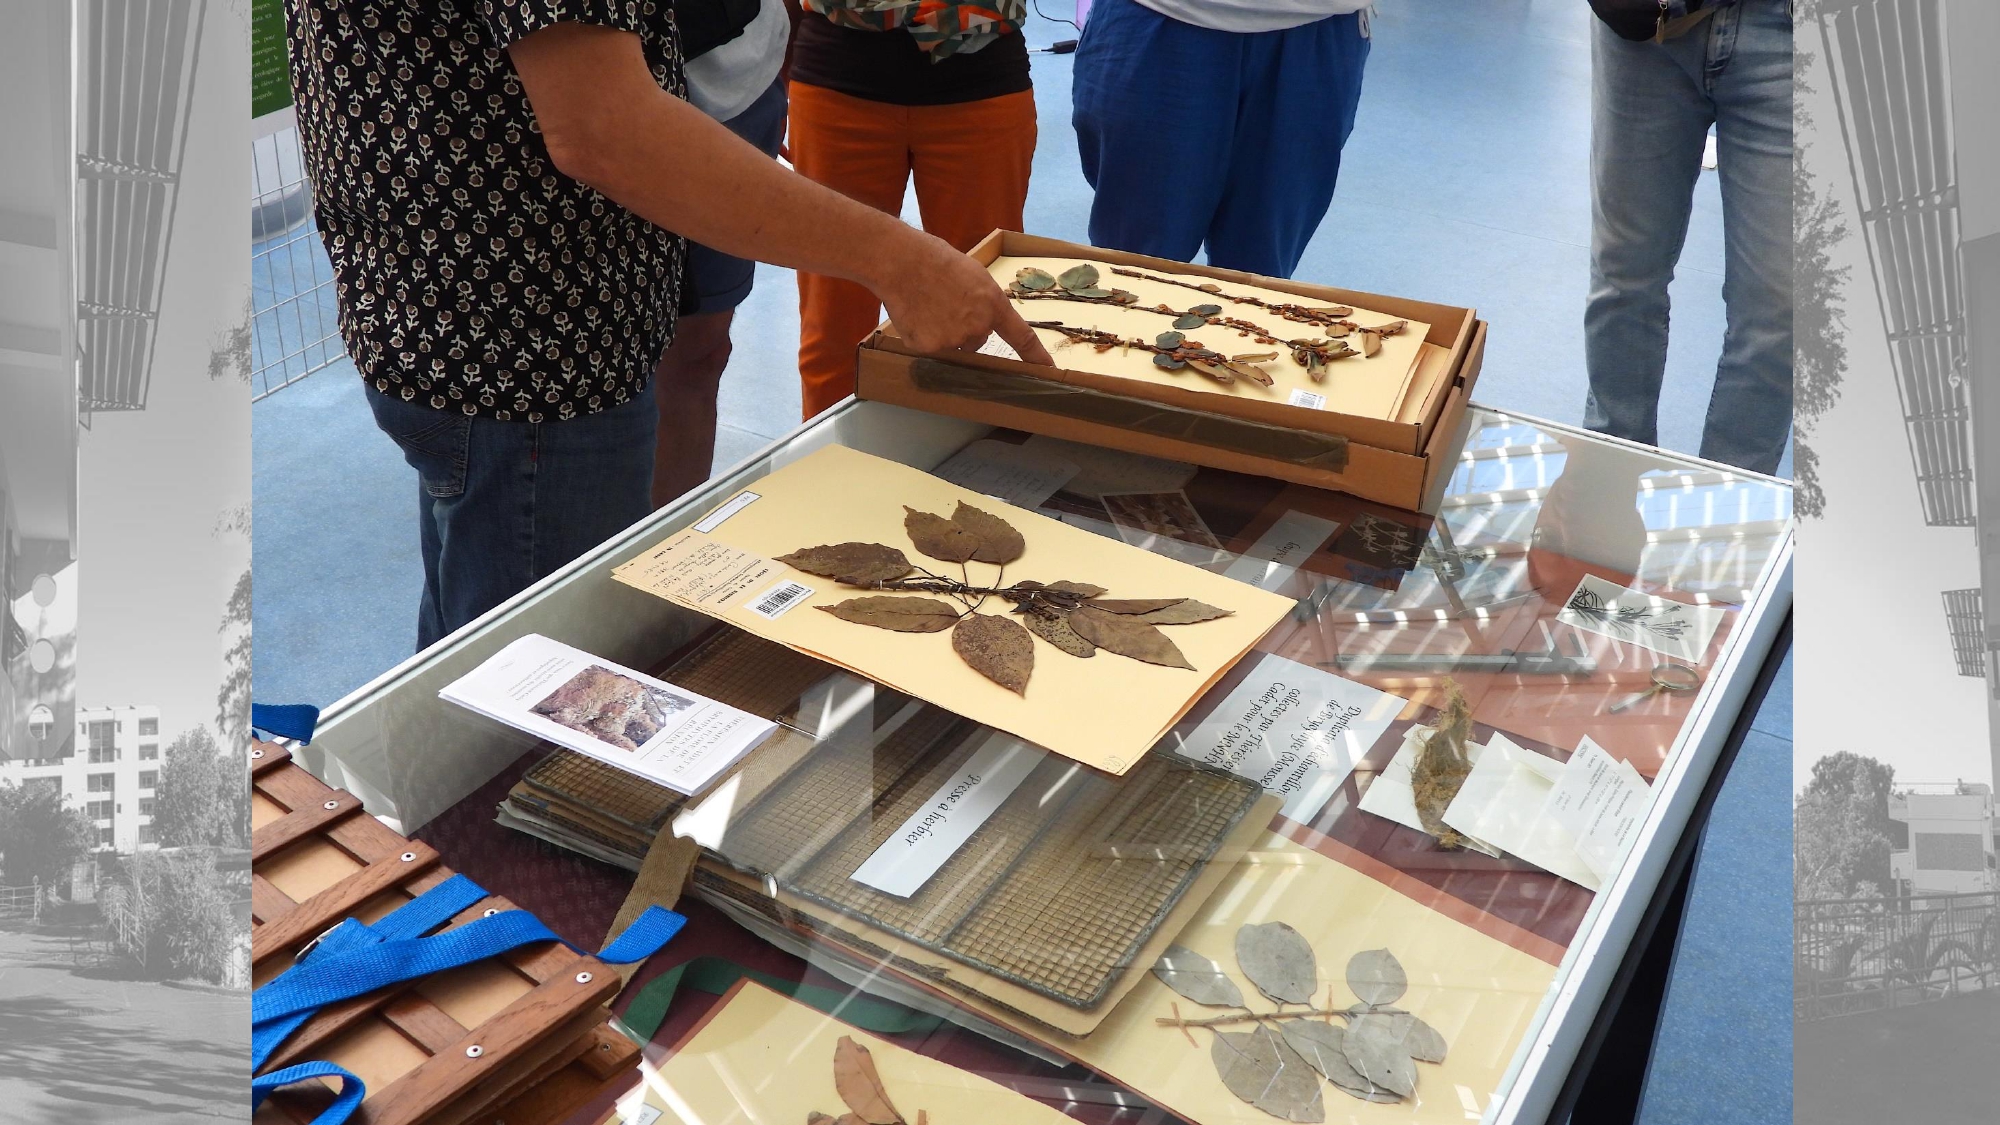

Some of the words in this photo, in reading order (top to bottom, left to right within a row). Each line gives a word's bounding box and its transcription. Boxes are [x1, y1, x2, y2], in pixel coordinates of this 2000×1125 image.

[1258, 682, 1286, 705] Cadet
[1270, 688, 1300, 718] collectes
[1326, 699, 1343, 711] de
[1243, 699, 1263, 724] pour
[1257, 713, 1274, 734] par
[1324, 706, 1362, 746] Duplicata
[1233, 722, 1251, 732] le
[1204, 731, 1241, 765] MNHN
[1222, 733, 1263, 772] Thérésien
[1260, 751, 1299, 790] (Mousse)
[946, 774, 982, 803] Presse
[905, 811, 947, 847] herbier
